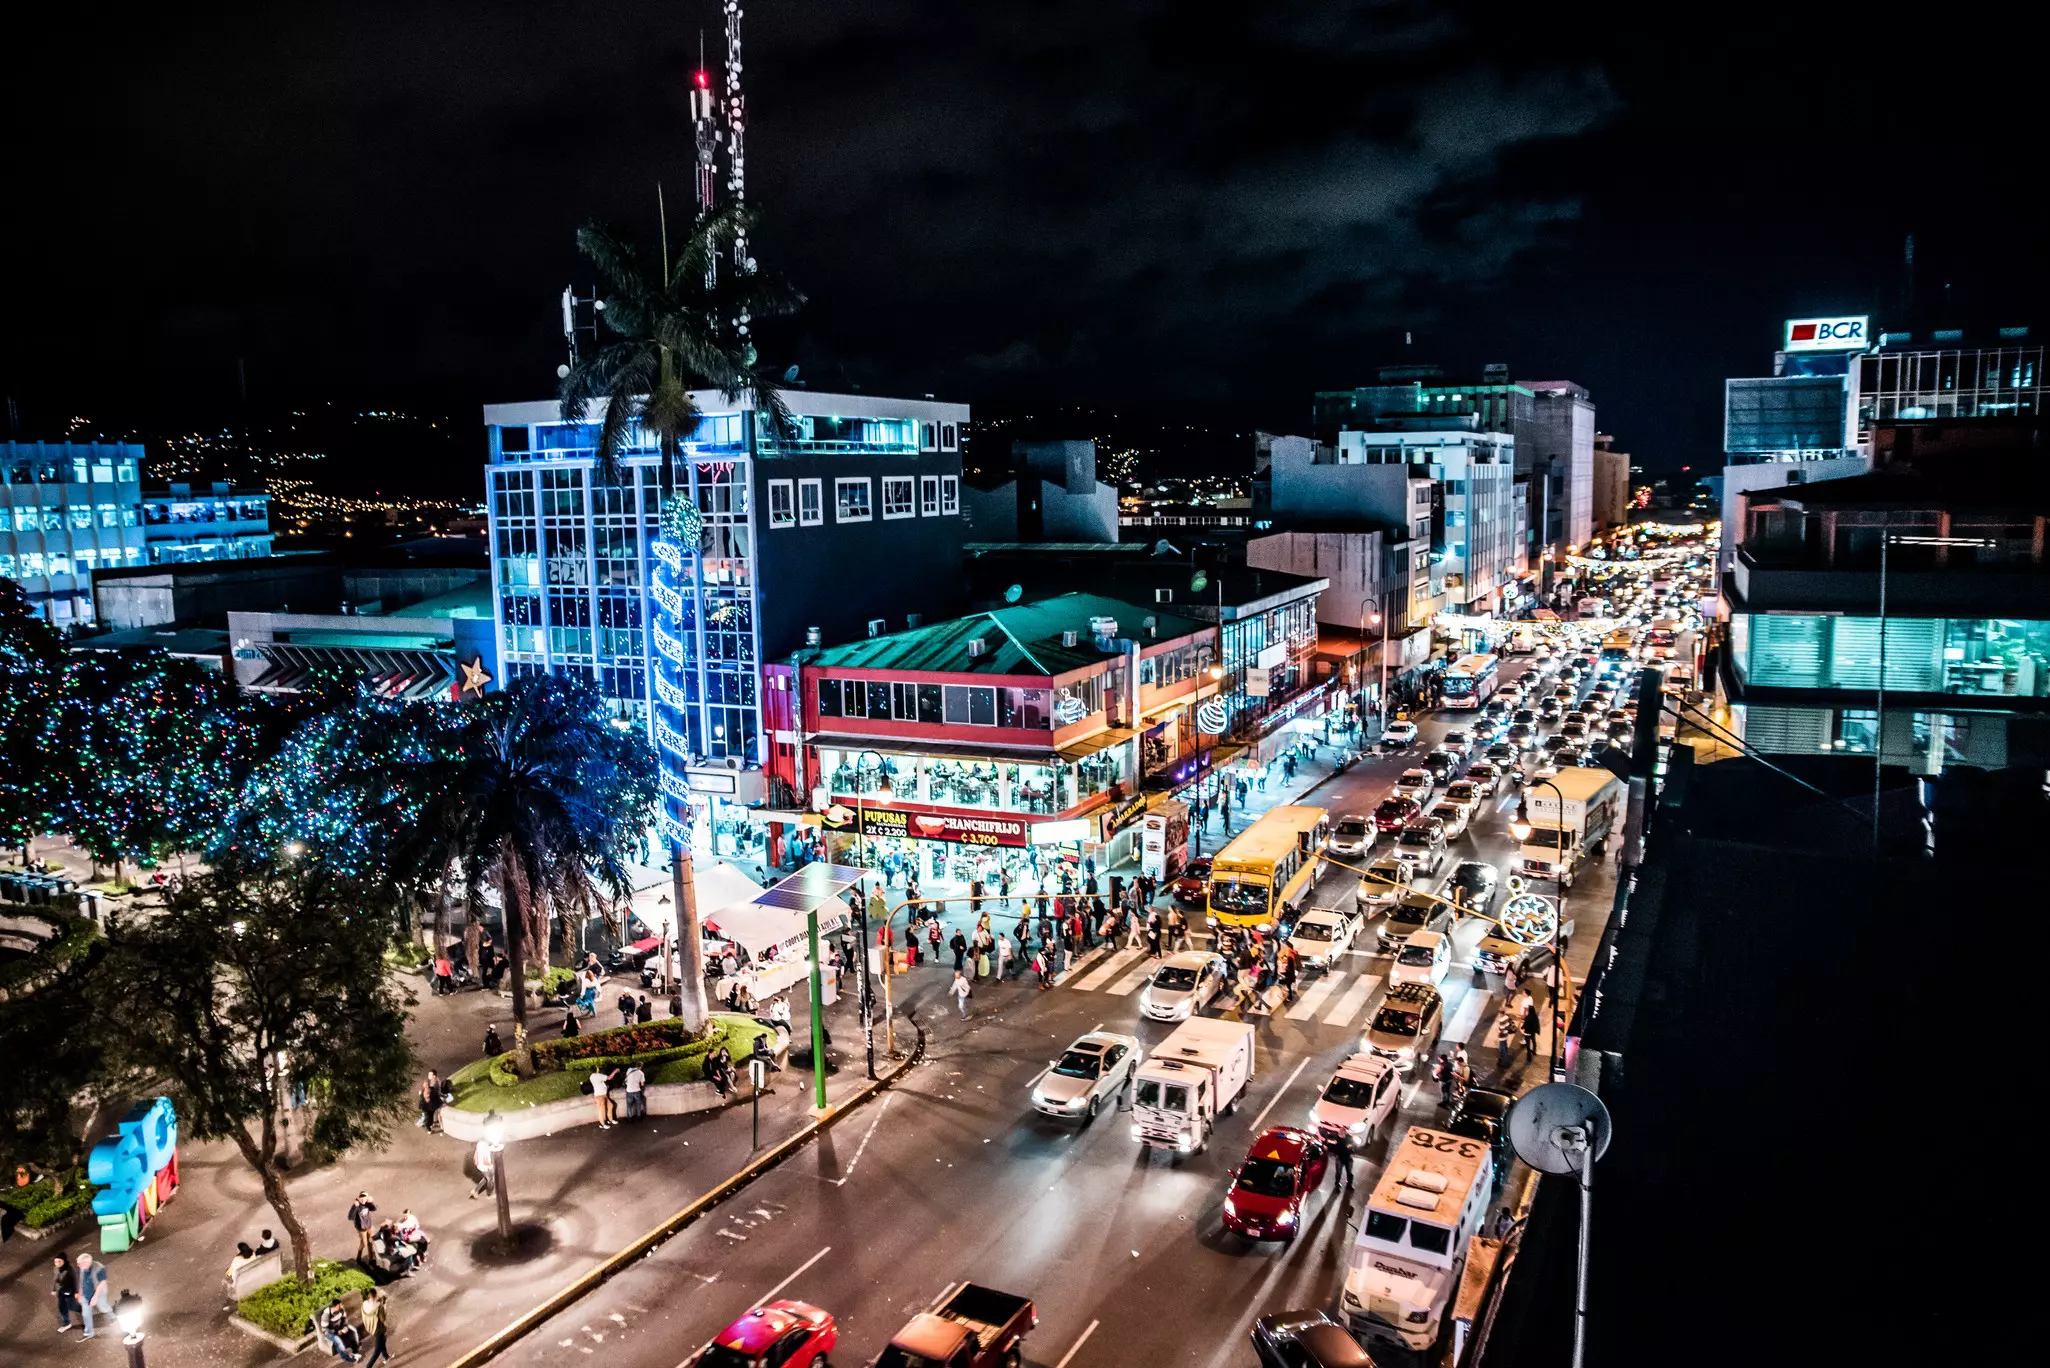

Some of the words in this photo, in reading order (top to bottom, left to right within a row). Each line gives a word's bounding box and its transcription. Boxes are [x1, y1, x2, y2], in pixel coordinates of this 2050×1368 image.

[1819, 321, 1862, 339] BCR
[864, 810, 907, 824] PUPUSAS
[885, 829, 907, 837] 2.200
[944, 817, 1020, 835] CHANCHIFRIJO
[971, 834, 998, 846] 3.700
[1411, 1132, 1480, 1158] 326
[1374, 1261, 1418, 1278] Dunbar
